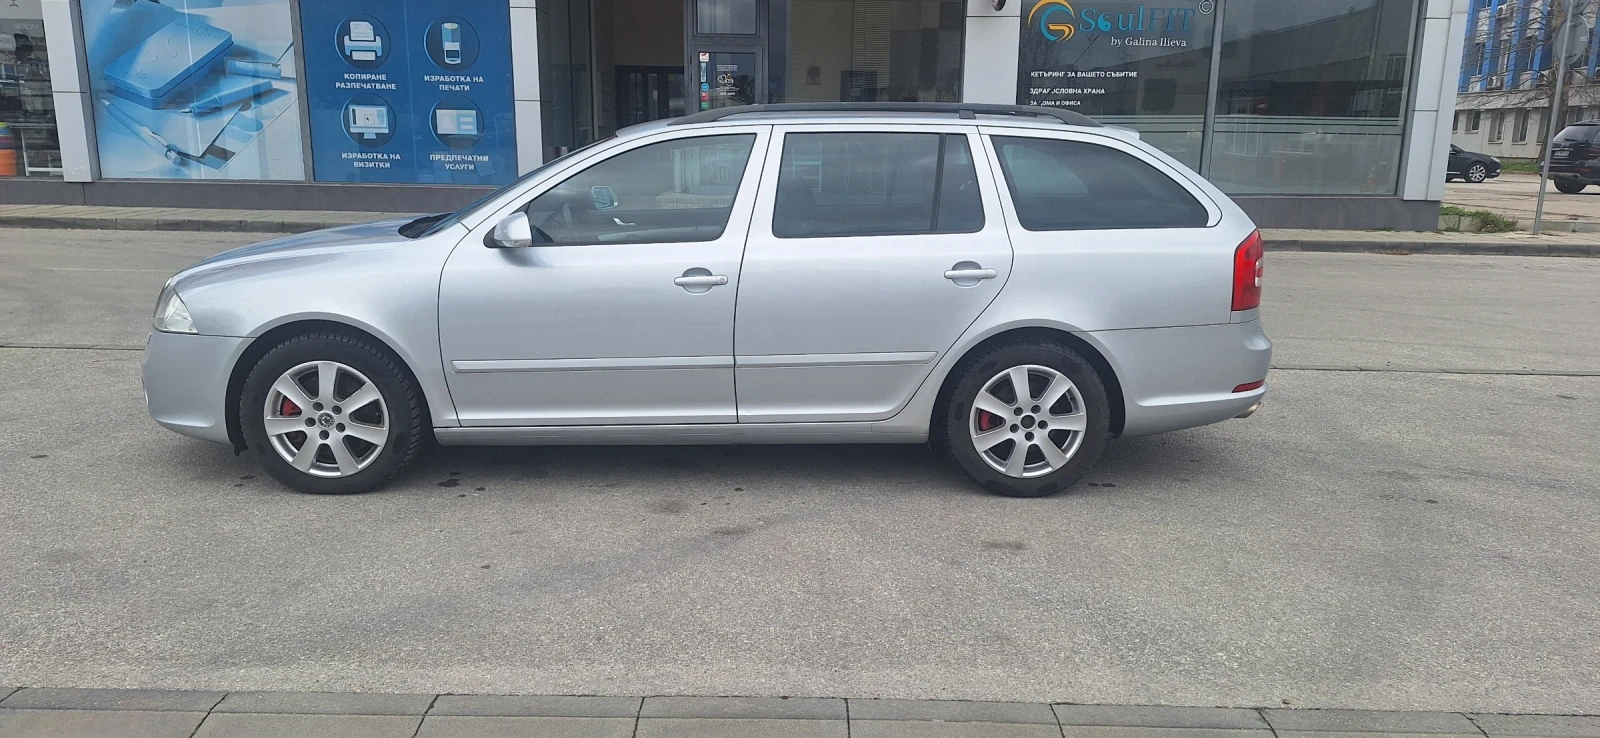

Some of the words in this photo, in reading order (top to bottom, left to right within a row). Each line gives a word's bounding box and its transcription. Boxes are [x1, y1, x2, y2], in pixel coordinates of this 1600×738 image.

[1110, 36, 1123, 48] by
[1124, 37, 1158, 46] Galina
[1159, 38, 1187, 47] Ilieva
[343, 73, 387, 81] КОПИРАНЕ
[424, 75, 471, 83] ИЗРАБОТКА
[335, 82, 397, 90] РАЗПЕЧАТВАНЕ
[439, 84, 470, 92] ПЕЧАТИ
[341, 152, 388, 160] ИЗРАБОТКА
[429, 154, 489, 162] ПРЕДПЕЧАТНИ
[353, 161, 391, 169] ВИЗИТКИ
[444, 163, 475, 171] УСЛУГИ
